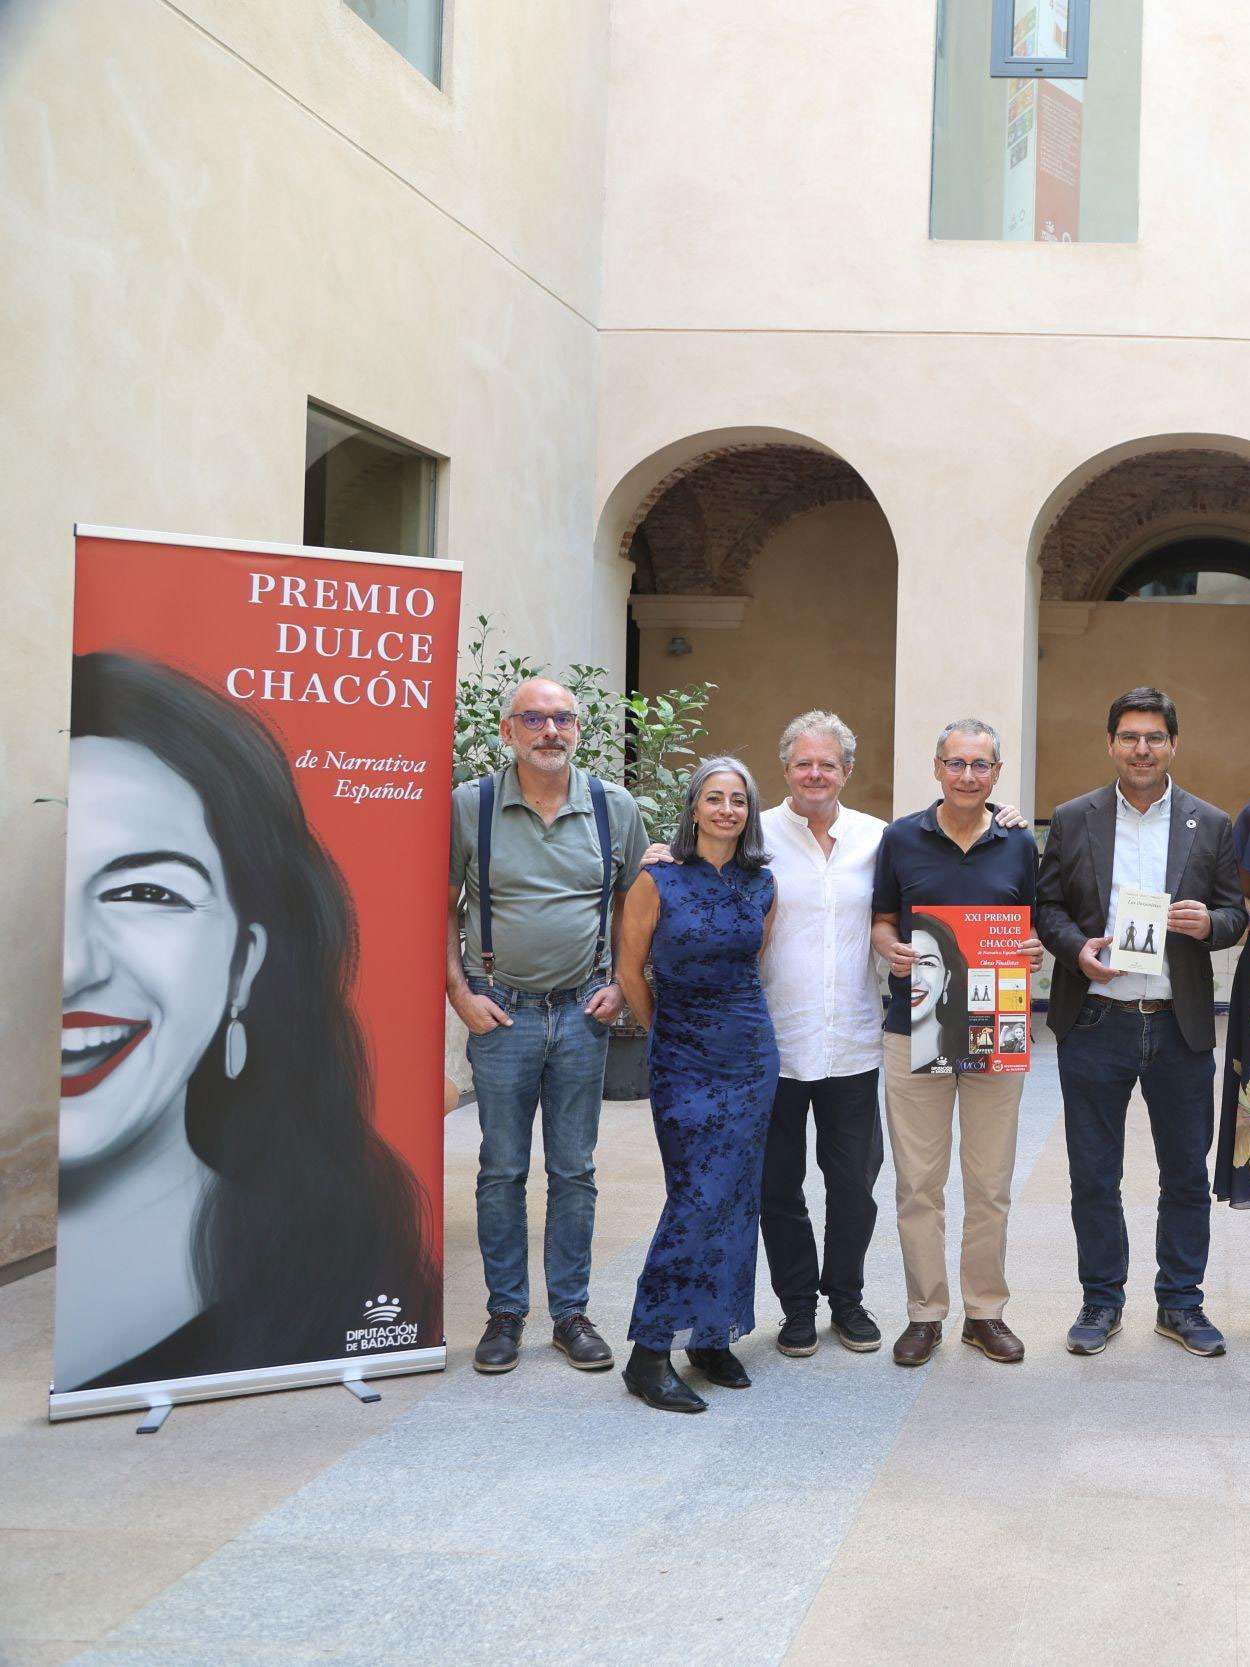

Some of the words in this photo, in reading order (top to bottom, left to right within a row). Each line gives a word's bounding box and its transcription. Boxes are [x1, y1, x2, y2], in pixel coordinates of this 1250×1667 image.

[248, 573, 435, 618] PREMIO
[276, 622, 433, 664] DULCE
[225, 667, 433, 709] CHACÓN
[295, 749, 319, 769] de
[323, 750, 426, 773] Narrativa
[333, 779, 423, 804] Española
[964, 913, 981, 921] XXI
[984, 913, 1021, 921] PREMIO
[989, 926, 1021, 934] DULCE
[979, 938, 1020, 948] CHACÓN
[346, 1321, 418, 1341] DIPUTACIÓN
[346, 1343, 358, 1352] DE
[361, 1333, 417, 1350] BADAJOZ
